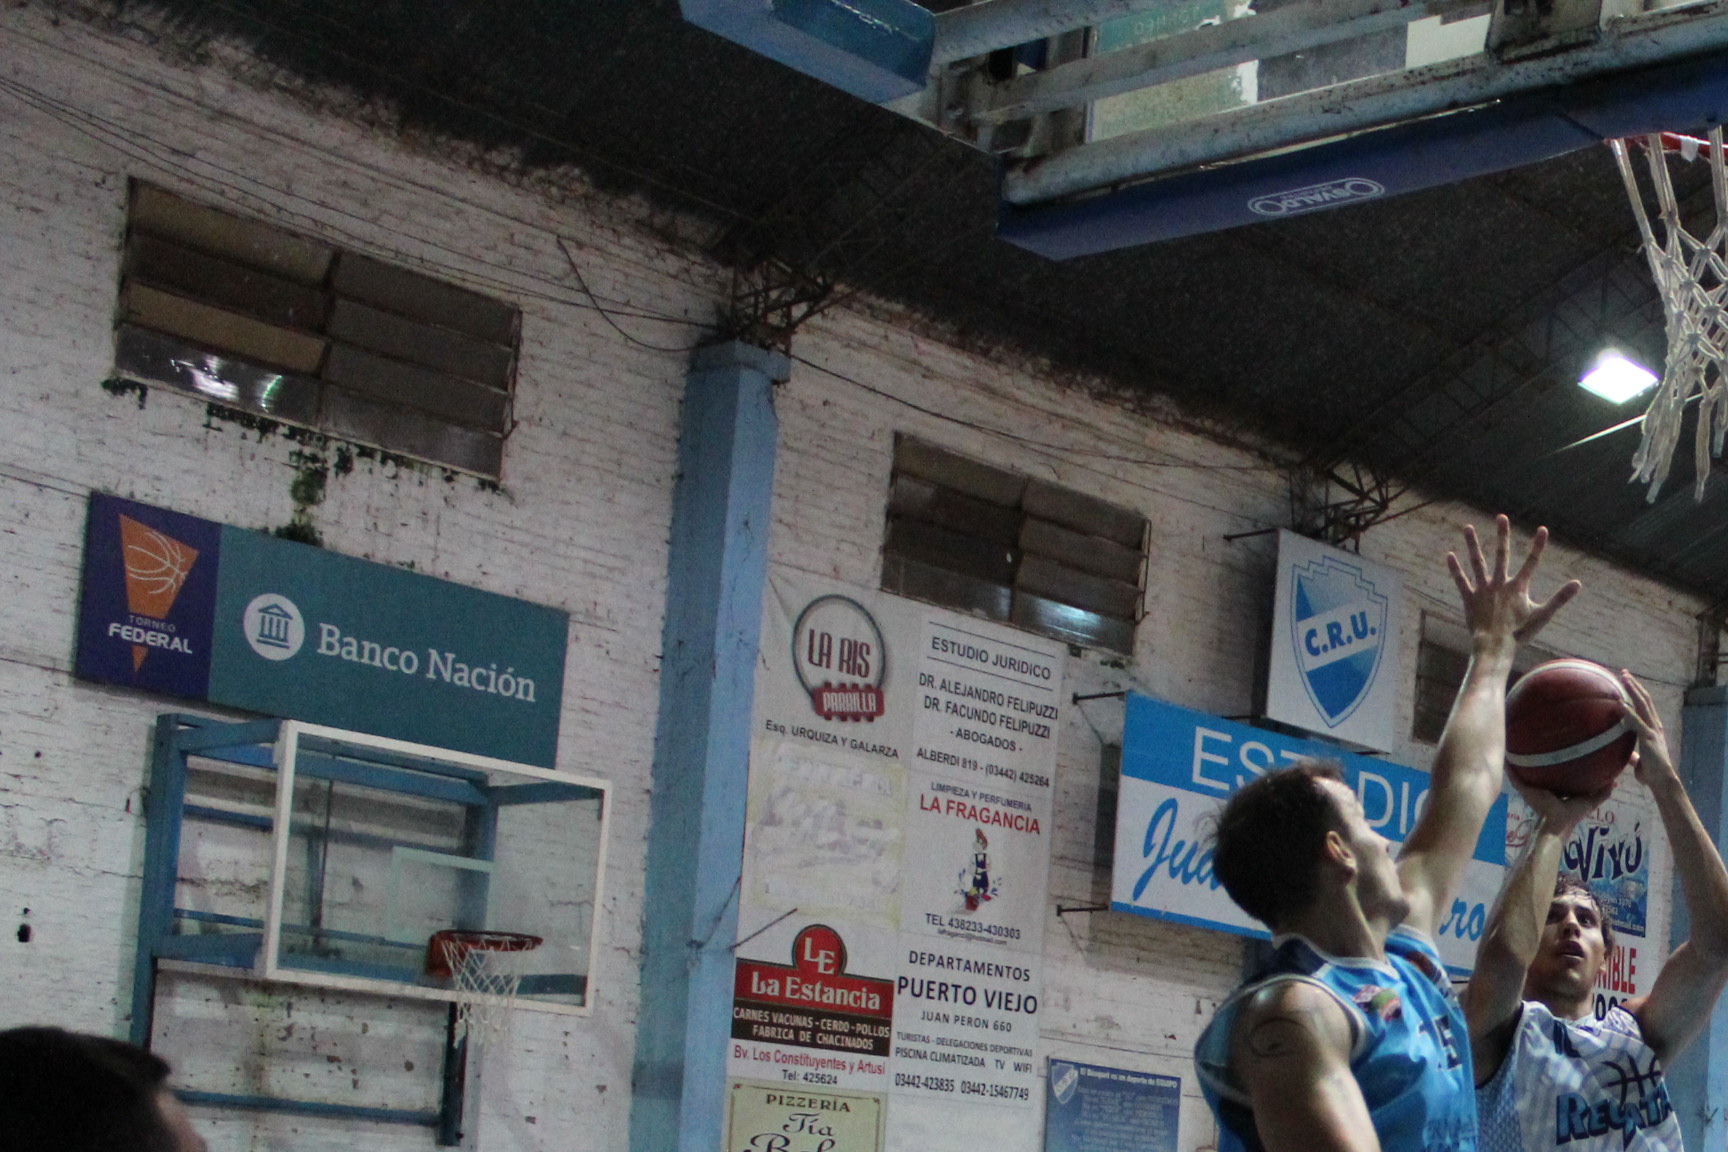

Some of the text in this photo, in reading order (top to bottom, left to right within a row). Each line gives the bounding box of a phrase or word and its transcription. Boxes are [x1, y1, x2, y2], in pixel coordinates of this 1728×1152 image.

[108, 622, 193, 654] FEDERAL
[128, 614, 176, 633] TORNEO
[1304, 611, 1377, 657] C.R.U.
[316, 622, 536, 702] Banco Nación
[808, 628, 870, 679] LA RIS
[932, 636, 1051, 680] ESTUDIO JURIDICO
[823, 691, 877, 713] PARRILLA
[919, 672, 1059, 721] DR. ALEJANDRO FELIPUZZI
[924, 695, 1050, 739] DR. FACUNDO FELIPUZZI
[765, 719, 899, 759] Esq. URQUIZA Y GALARZA
[955, 728, 1017, 752] ABOGADOS
[917, 747, 1050, 788] ALBERDI 819 (03442) 425264
[931, 782, 970, 799] LIMPIEZA
[979, 793, 1032, 812] PERFUMERIA
[920, 793, 1041, 835] LA FRAGANCIA
[925, 912, 945, 927] TEL
[909, 950, 1031, 982] DEPARTAMENTOS
[751, 971, 881, 1010] La Estancia
[897, 975, 1038, 1014] PUERTO VIEJO
[733, 1007, 890, 1038] CARNES VACUNAS CERDO POLLOS
[921, 1010, 1012, 1032] JUAN PERON 660
[752, 1024, 874, 1050] FABRICA DE CHACINADOS
[896, 1031, 1033, 1057] TURISTAS DELEGACIONES DEPORTIVAS
[752, 1048, 771, 1062] Los
[774, 1050, 847, 1072] Constituyentes
[857, 1060, 886, 1075] Artusi
[895, 1047, 1032, 1073] PISCINA CLIMATIZADA TV WIFI
[802, 1072, 838, 1085] 425624
[782, 1112, 836, 1137] Tía
